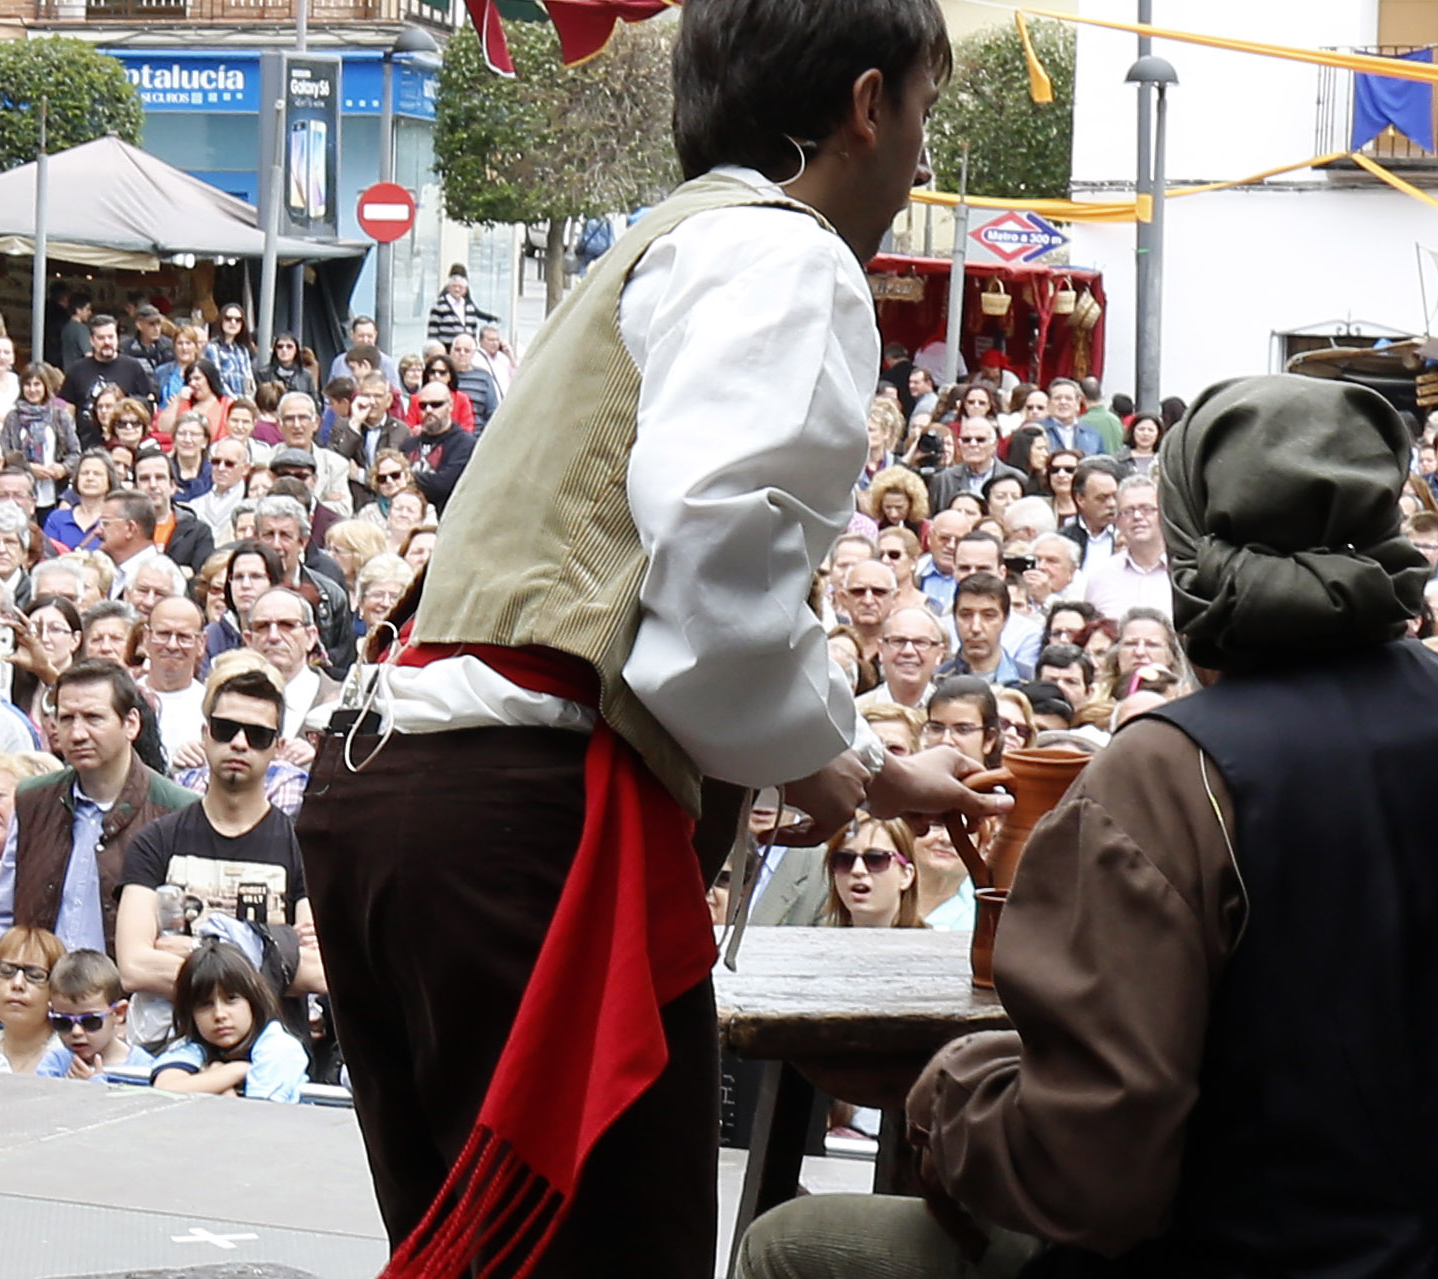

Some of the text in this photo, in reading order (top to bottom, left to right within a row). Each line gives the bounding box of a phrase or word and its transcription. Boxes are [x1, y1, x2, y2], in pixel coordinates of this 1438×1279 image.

[986, 229, 1063, 245] Metro a 300 m
